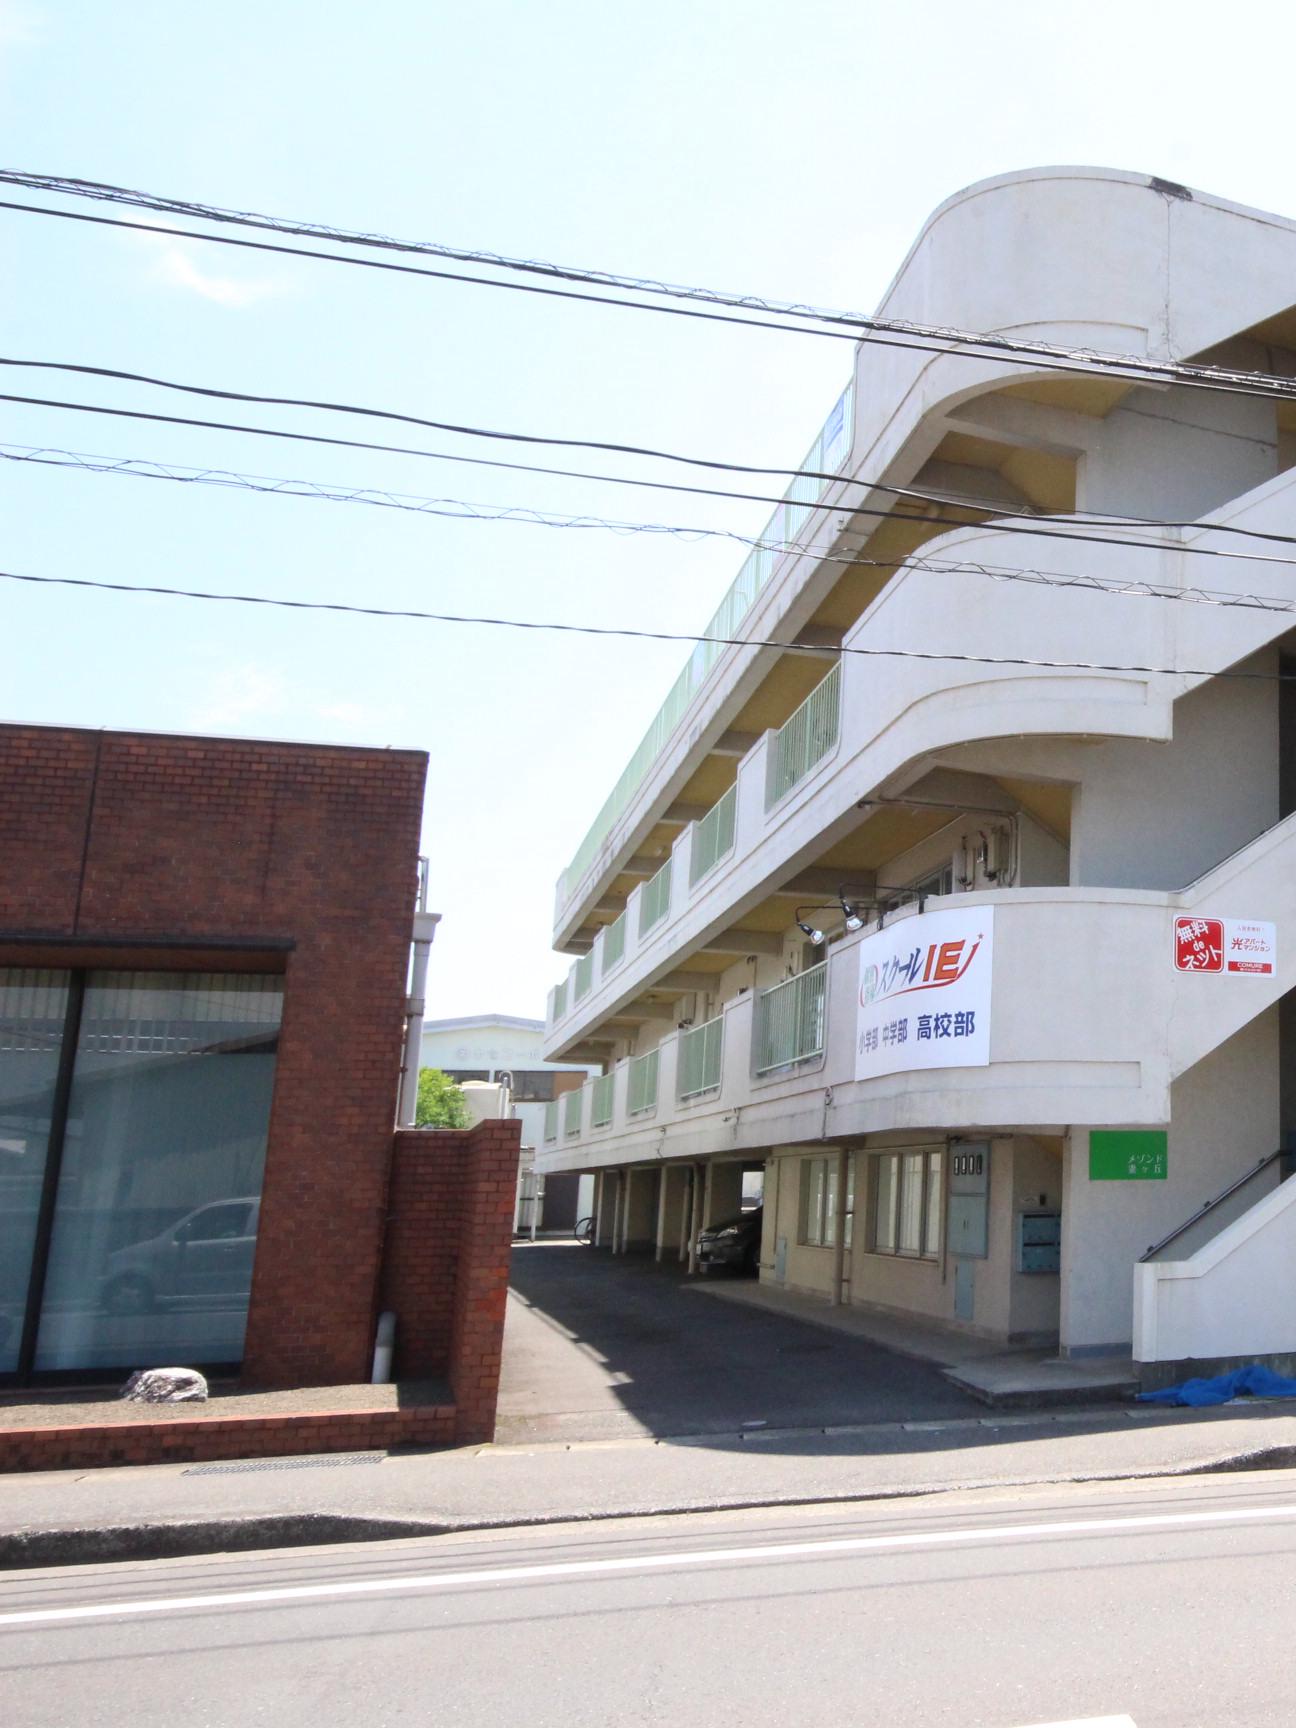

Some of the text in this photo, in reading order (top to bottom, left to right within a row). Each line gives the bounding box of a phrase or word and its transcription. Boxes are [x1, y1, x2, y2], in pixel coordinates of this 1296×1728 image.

[1177, 920, 1209, 944] 無料
[1183, 944, 1222, 969] ネット
[1193, 940, 1205, 951] de
[882, 1018, 908, 1048] 中学部
[917, 1011, 976, 1041] 高校部
